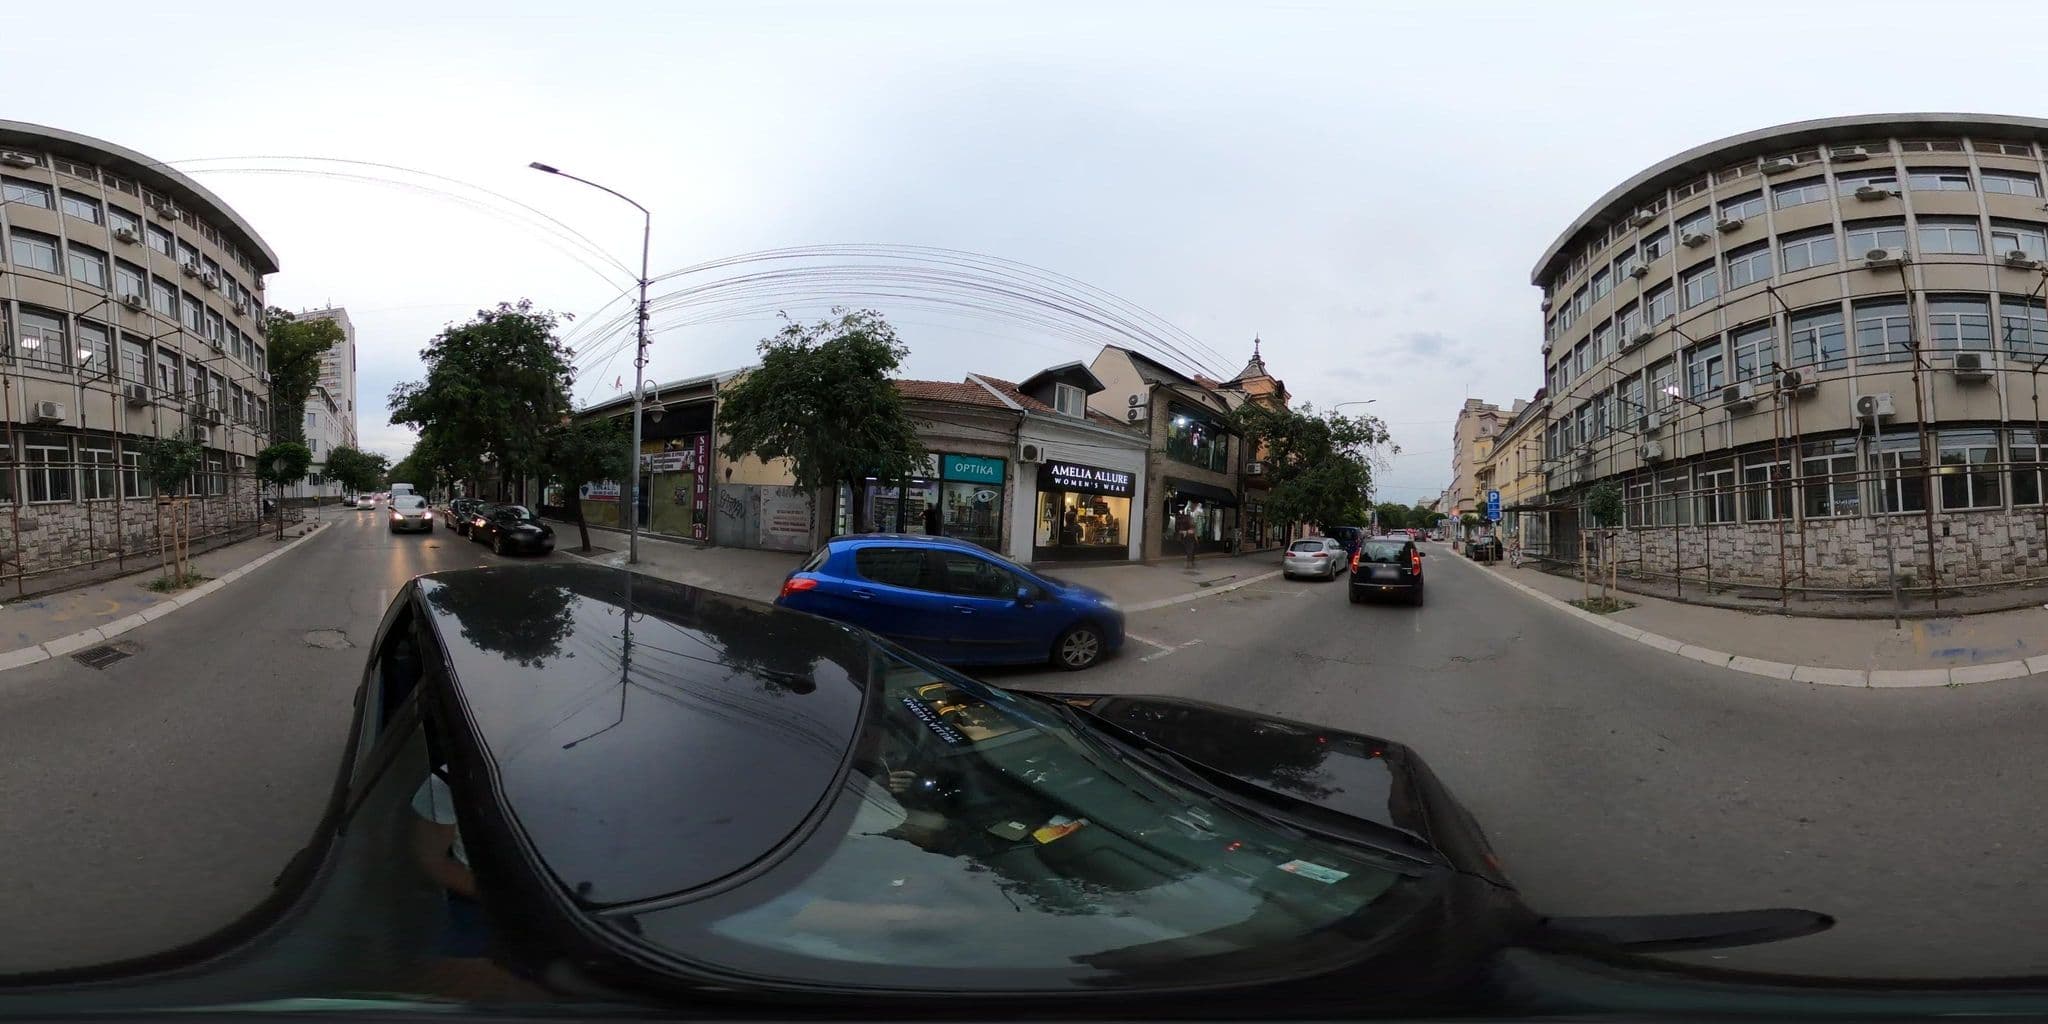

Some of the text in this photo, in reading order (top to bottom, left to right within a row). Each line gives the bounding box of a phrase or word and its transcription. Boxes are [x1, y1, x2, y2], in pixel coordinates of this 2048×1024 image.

[697, 435, 705, 494] SECOND
[955, 463, 994, 475] OPTIKA
[1051, 465, 1129, 484] AMELIA ALLURE
[1054, 478, 1126, 492] WOMEN'S WEAR
[1490, 492, 1498, 502] P
